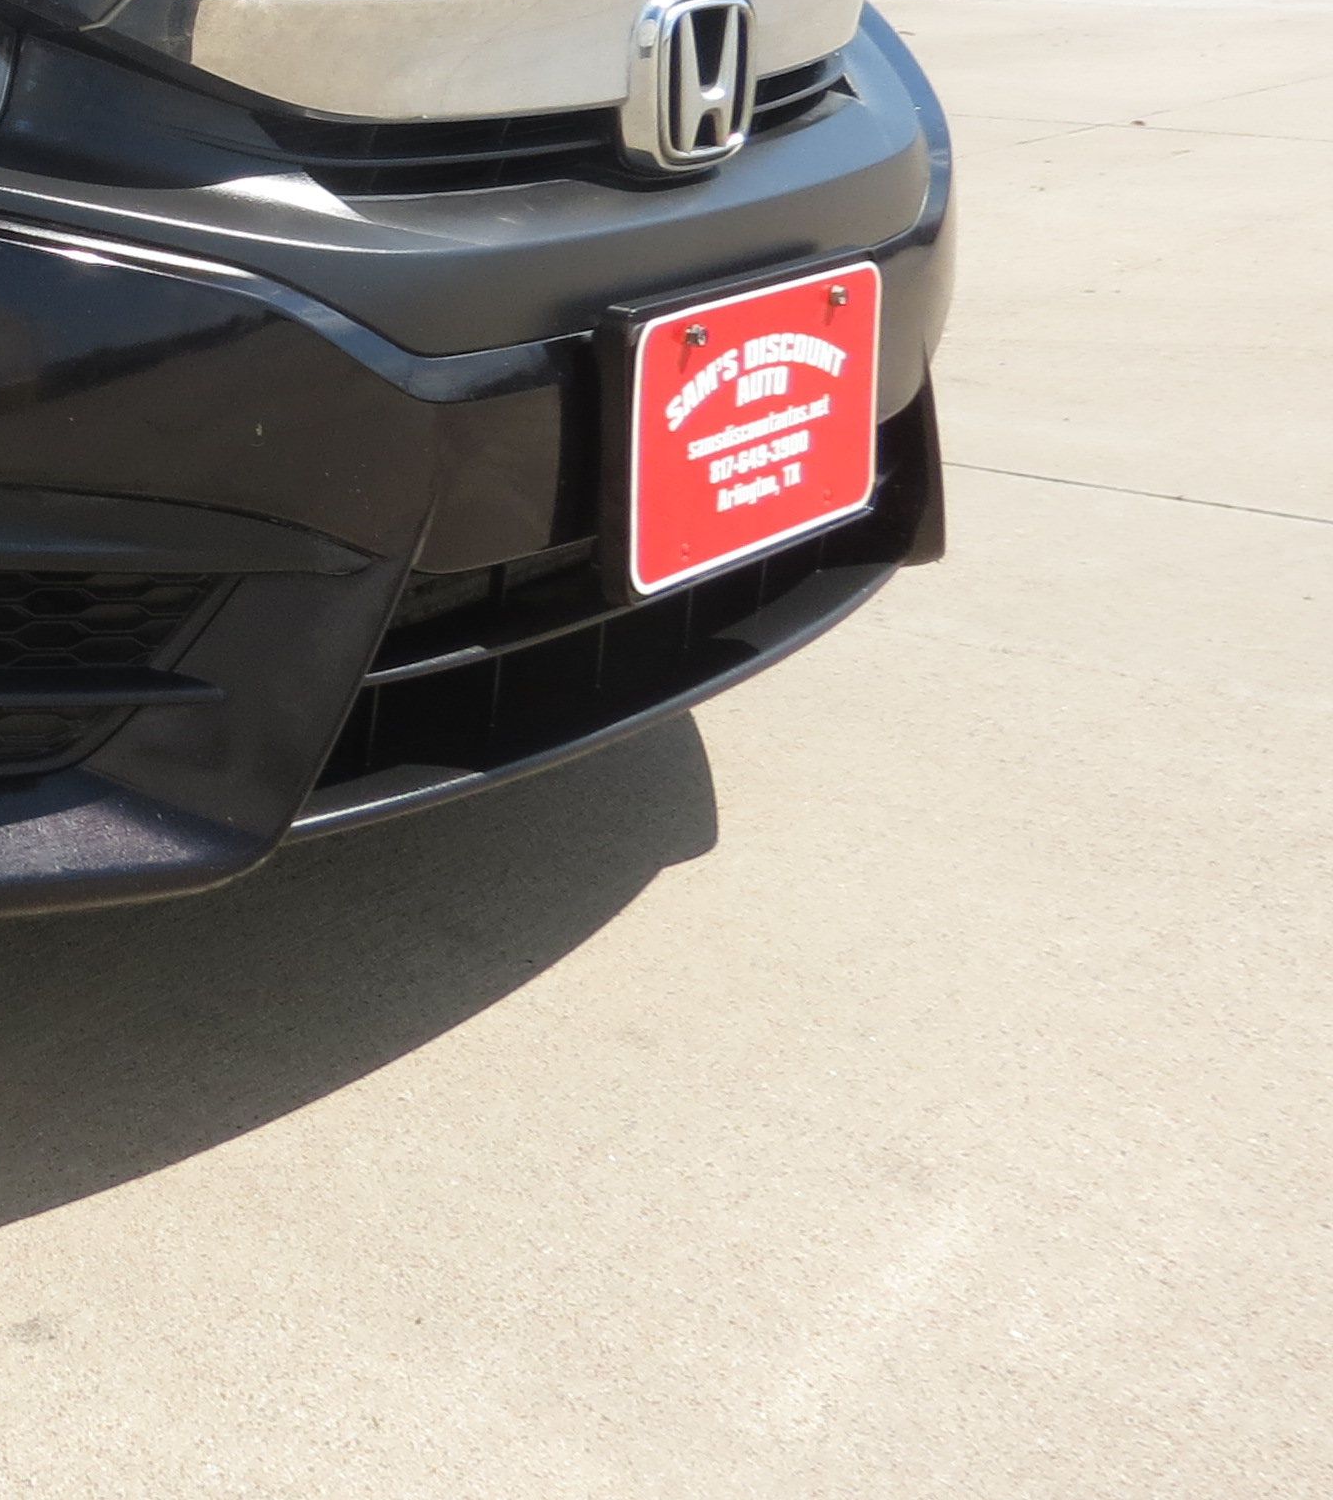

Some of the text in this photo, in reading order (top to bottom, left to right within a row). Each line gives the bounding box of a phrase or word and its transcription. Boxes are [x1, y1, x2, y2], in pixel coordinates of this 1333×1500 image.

[665, 332, 847, 432] SAM'S DISCOUNT
[735, 366, 789, 407] AUTO
